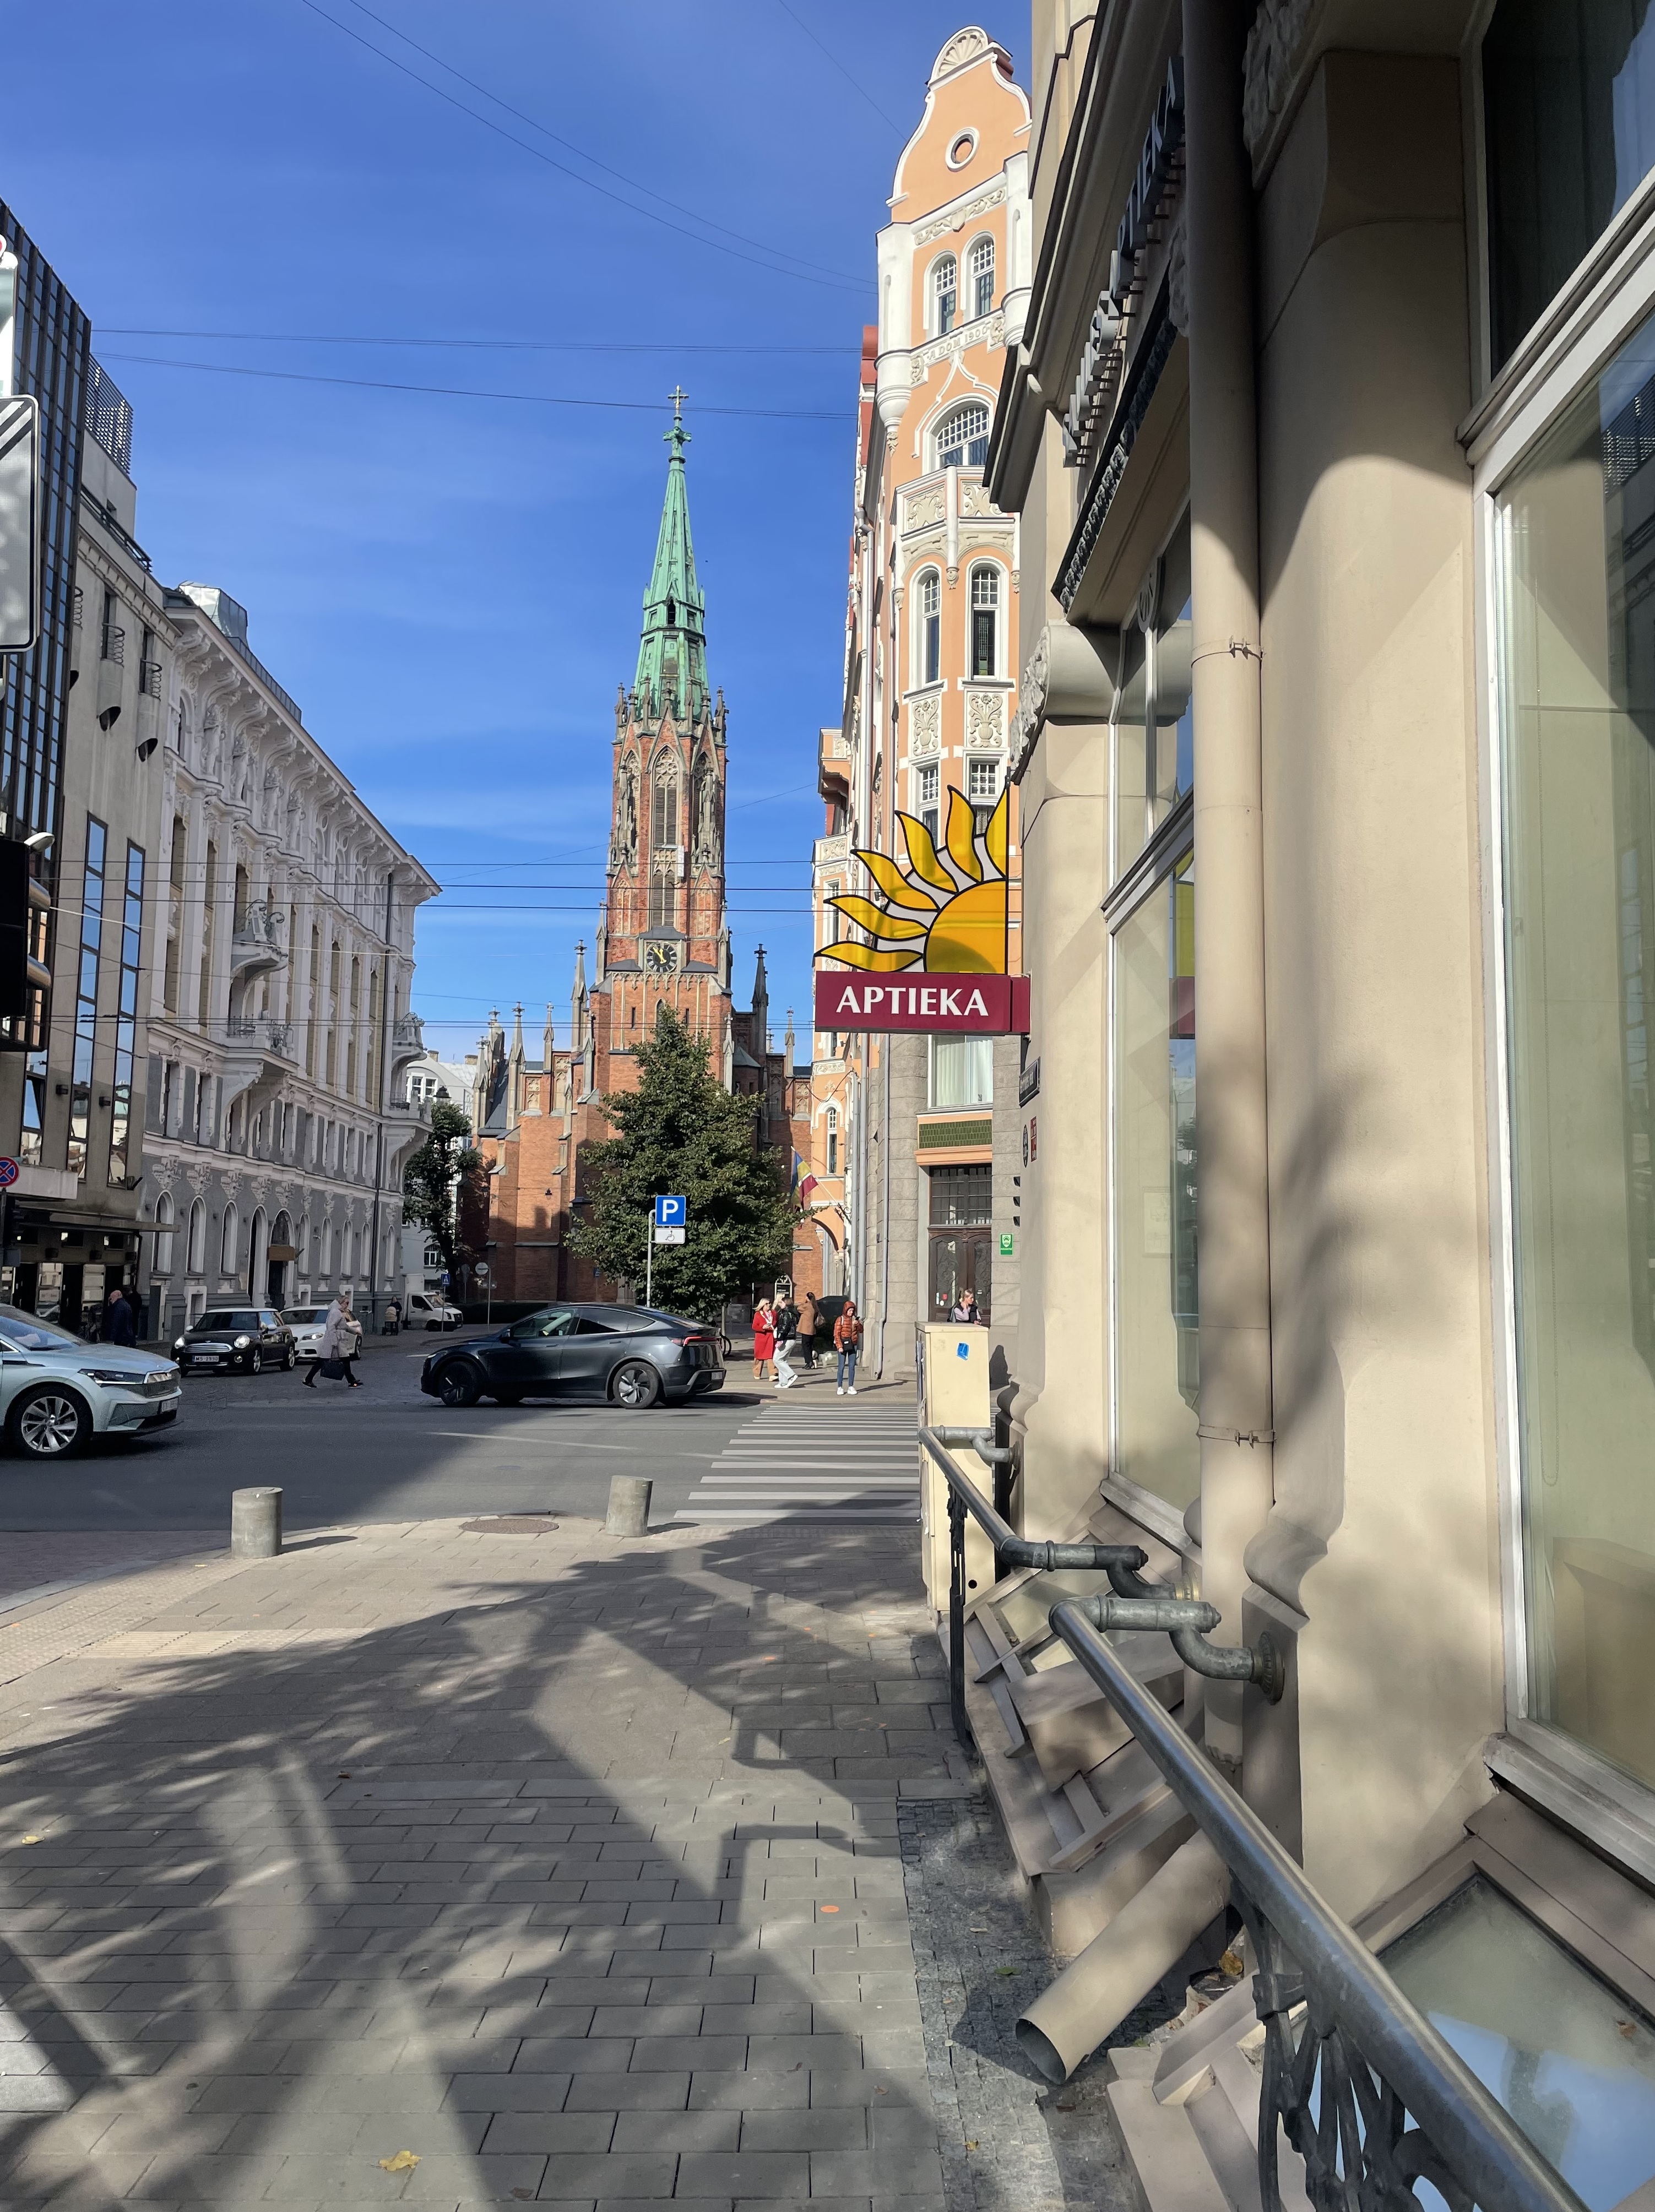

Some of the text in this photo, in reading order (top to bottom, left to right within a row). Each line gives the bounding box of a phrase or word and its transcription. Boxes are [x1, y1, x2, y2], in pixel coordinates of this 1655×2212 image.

[1109, 56, 1184, 300] APTIEKA
[938, 338, 961, 356] DOM
[964, 326, 988, 343] 1900
[835, 986, 989, 1017] APTIEKA
[662, 1199, 679, 1222] P
